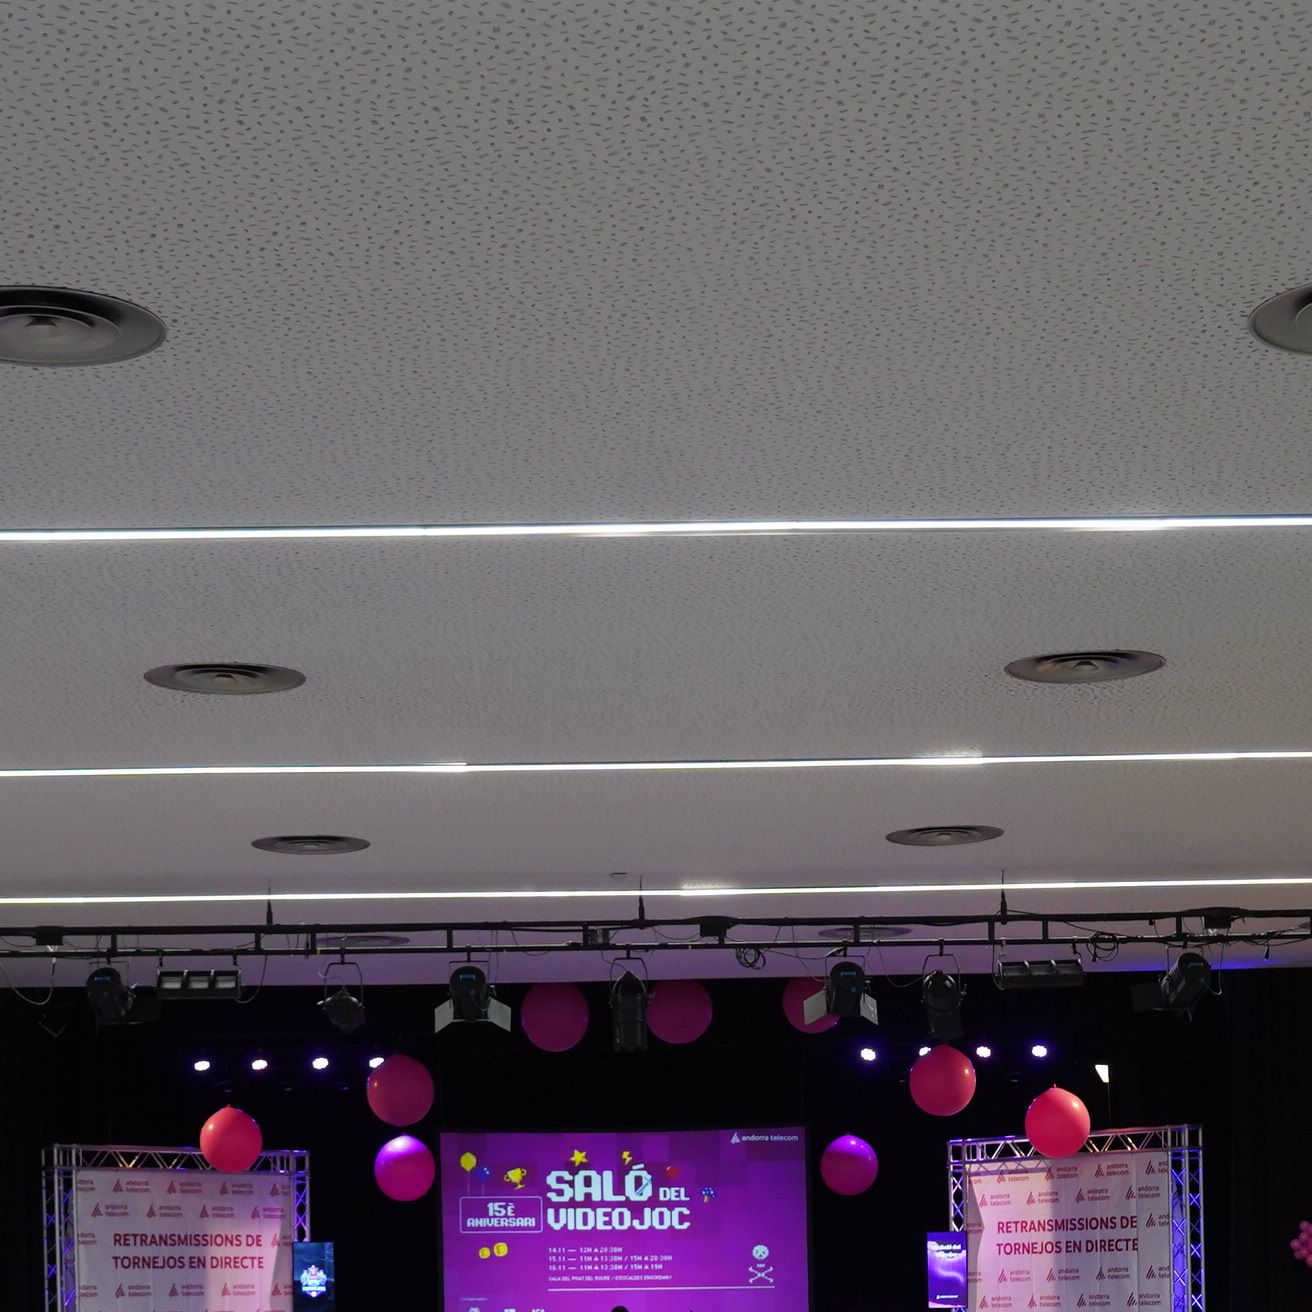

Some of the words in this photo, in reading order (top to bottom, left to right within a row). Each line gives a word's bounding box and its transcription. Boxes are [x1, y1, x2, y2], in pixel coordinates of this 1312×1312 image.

[546, 1163, 653, 1202] SALÓ
[660, 1188, 690, 1201] DEL
[488, 1202, 515, 1216] 15È
[467, 1218, 535, 1227] ANIVERSARI
[547, 1207, 690, 1230] VIDEOJOC
[997, 1216, 1117, 1234] RETRANSMISSIONS
[1121, 1215, 1137, 1229] DE
[113, 1233, 241, 1246] RETRANSMISSIONS
[246, 1234, 262, 1246] DE
[996, 1241, 1061, 1255] TORNEJOS
[1066, 1240, 1082, 1253] EN
[1087, 1238, 1138, 1252] DIRECTE
[112, 1256, 185, 1269] TORNEJOS
[190, 1256, 206, 1268] EN
[211, 1256, 264, 1268] DIRECTE
